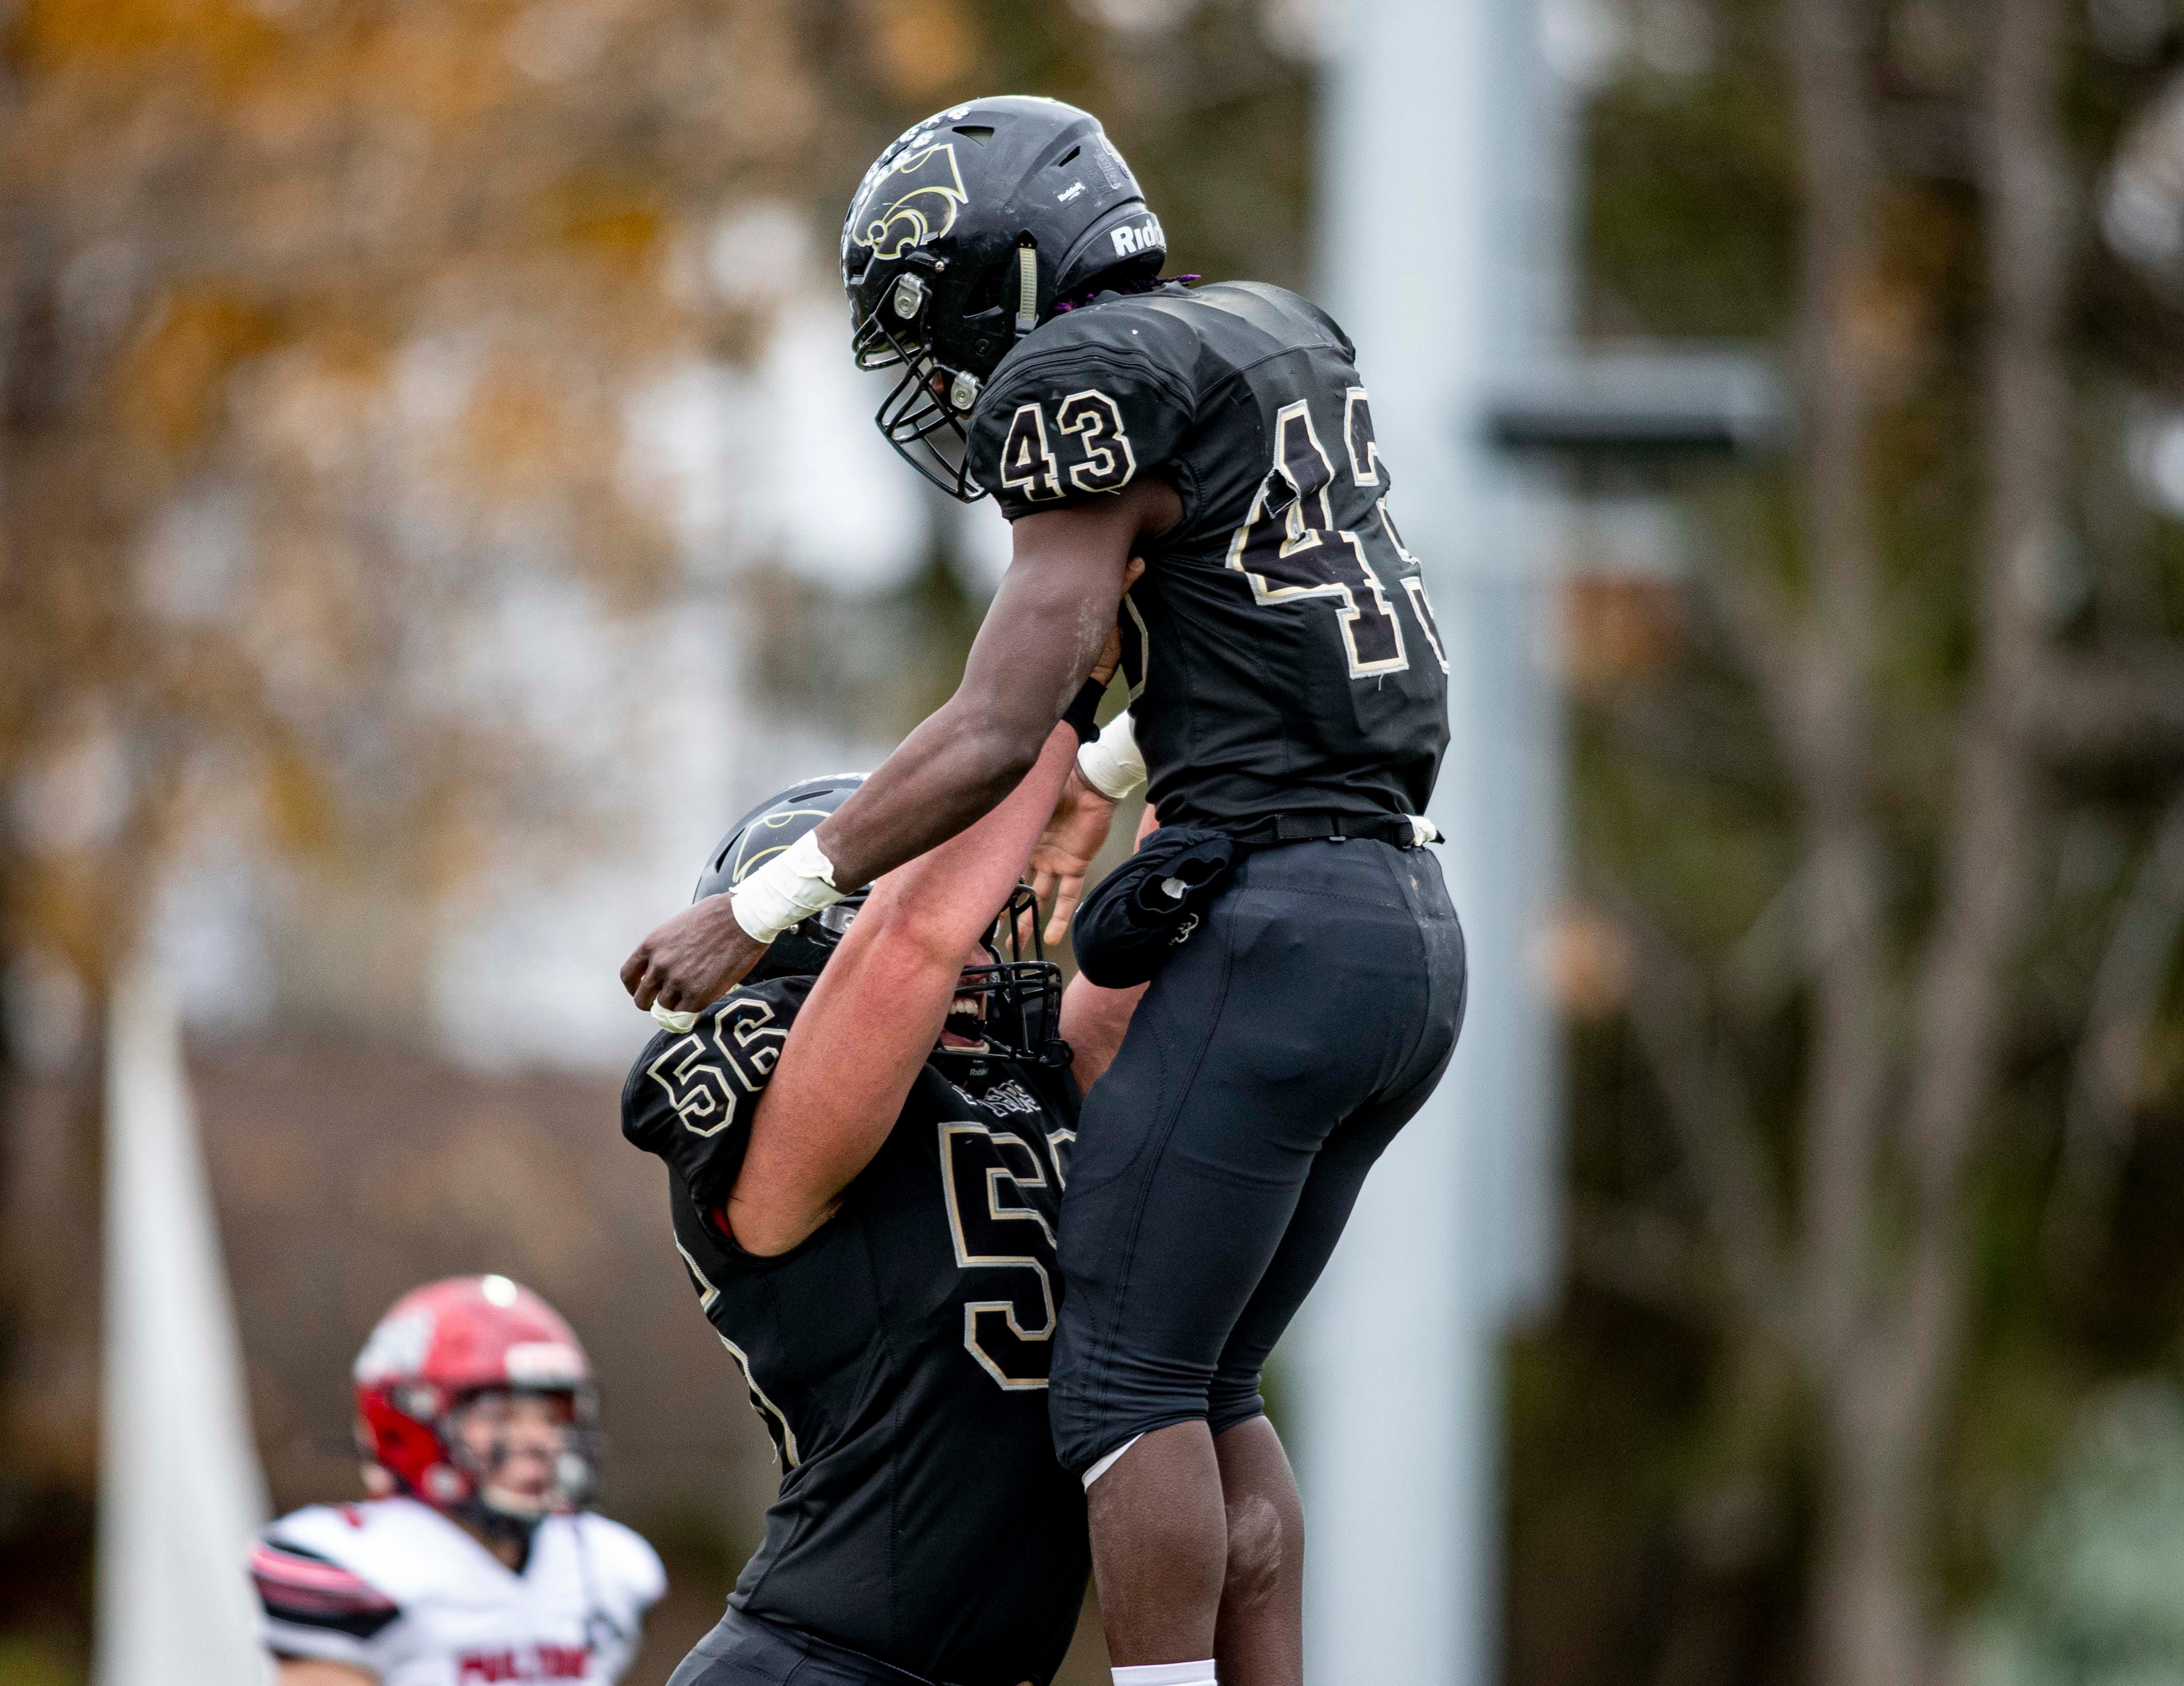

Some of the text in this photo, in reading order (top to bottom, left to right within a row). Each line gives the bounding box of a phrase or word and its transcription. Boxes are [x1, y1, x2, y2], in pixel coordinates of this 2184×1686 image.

[1110, 218, 1167, 258] Ridd
[1000, 389, 1136, 502] 43
[647, 999, 788, 1137] 56
[938, 1122, 1076, 1390] 5
